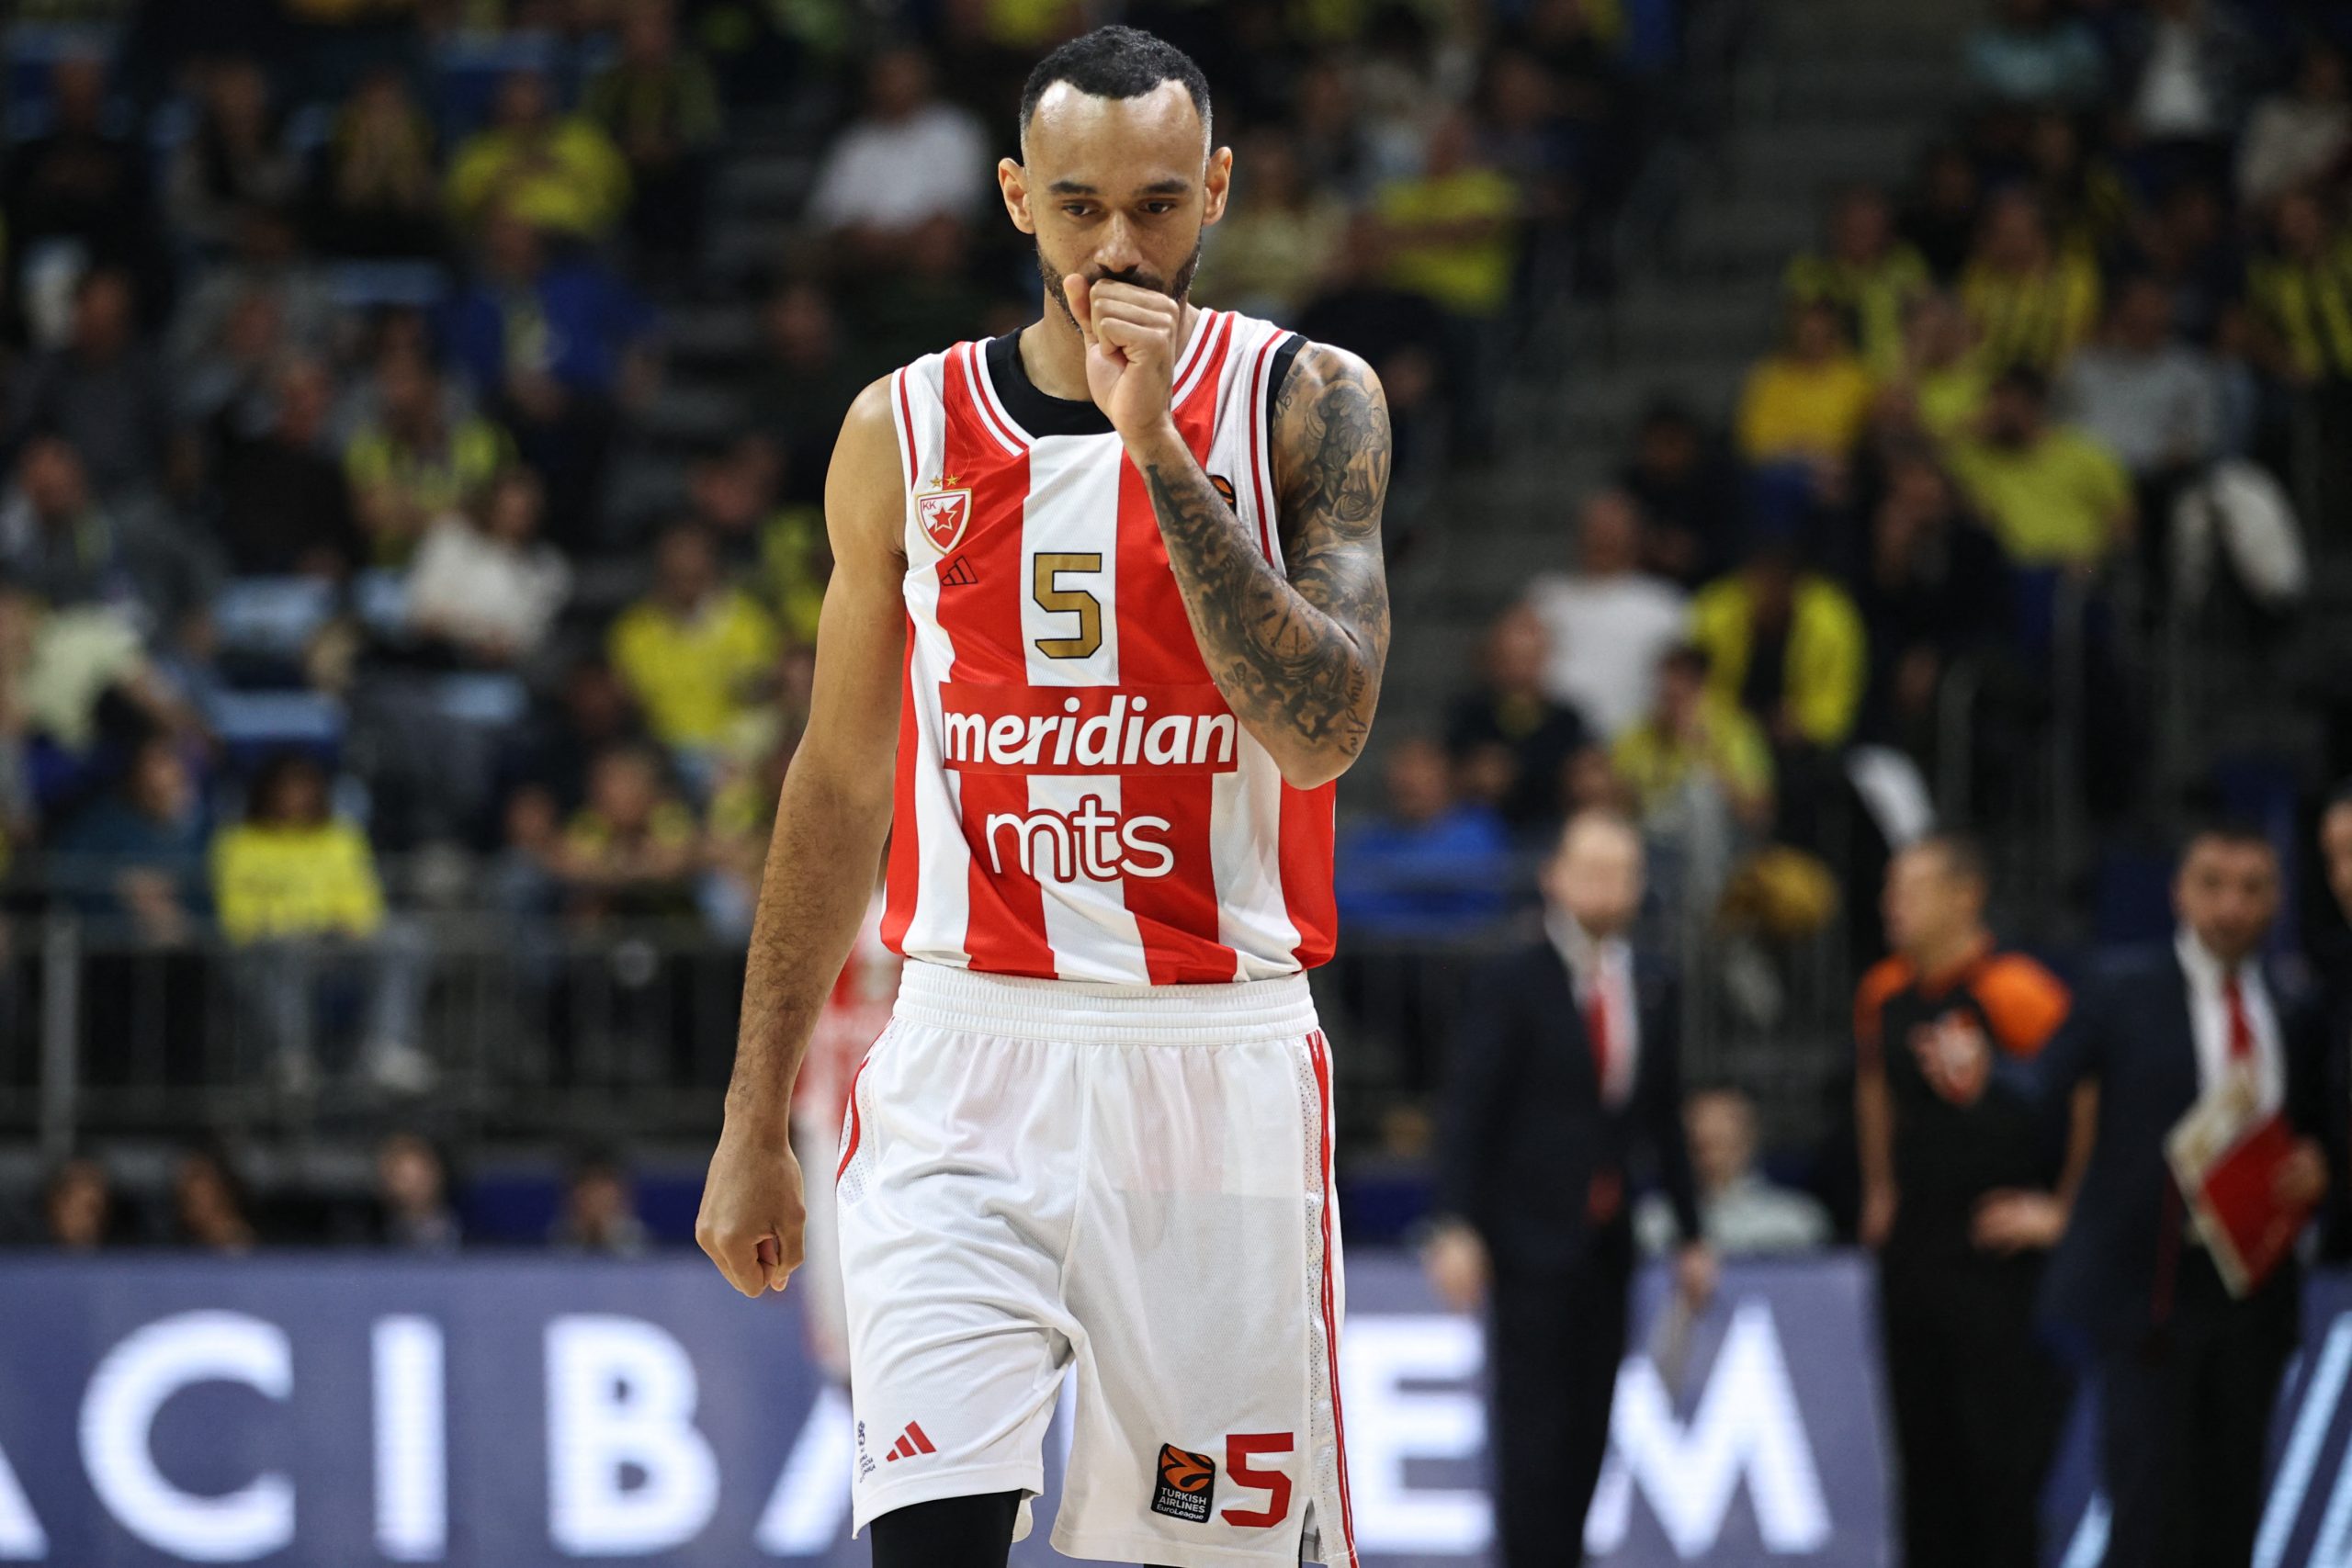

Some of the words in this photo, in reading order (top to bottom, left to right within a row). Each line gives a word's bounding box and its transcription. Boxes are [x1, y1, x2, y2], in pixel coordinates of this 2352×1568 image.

[1032, 551, 1103, 660] 5
[944, 694, 1237, 766] meridian
[985, 798, 1175, 878] mts
[1156, 1503, 1204, 1520] EuroLeague
[1158, 1495, 1206, 1514] AIRLINES
[1160, 1486, 1207, 1506] TURKISH
[1220, 1431, 1295, 1529] 5
